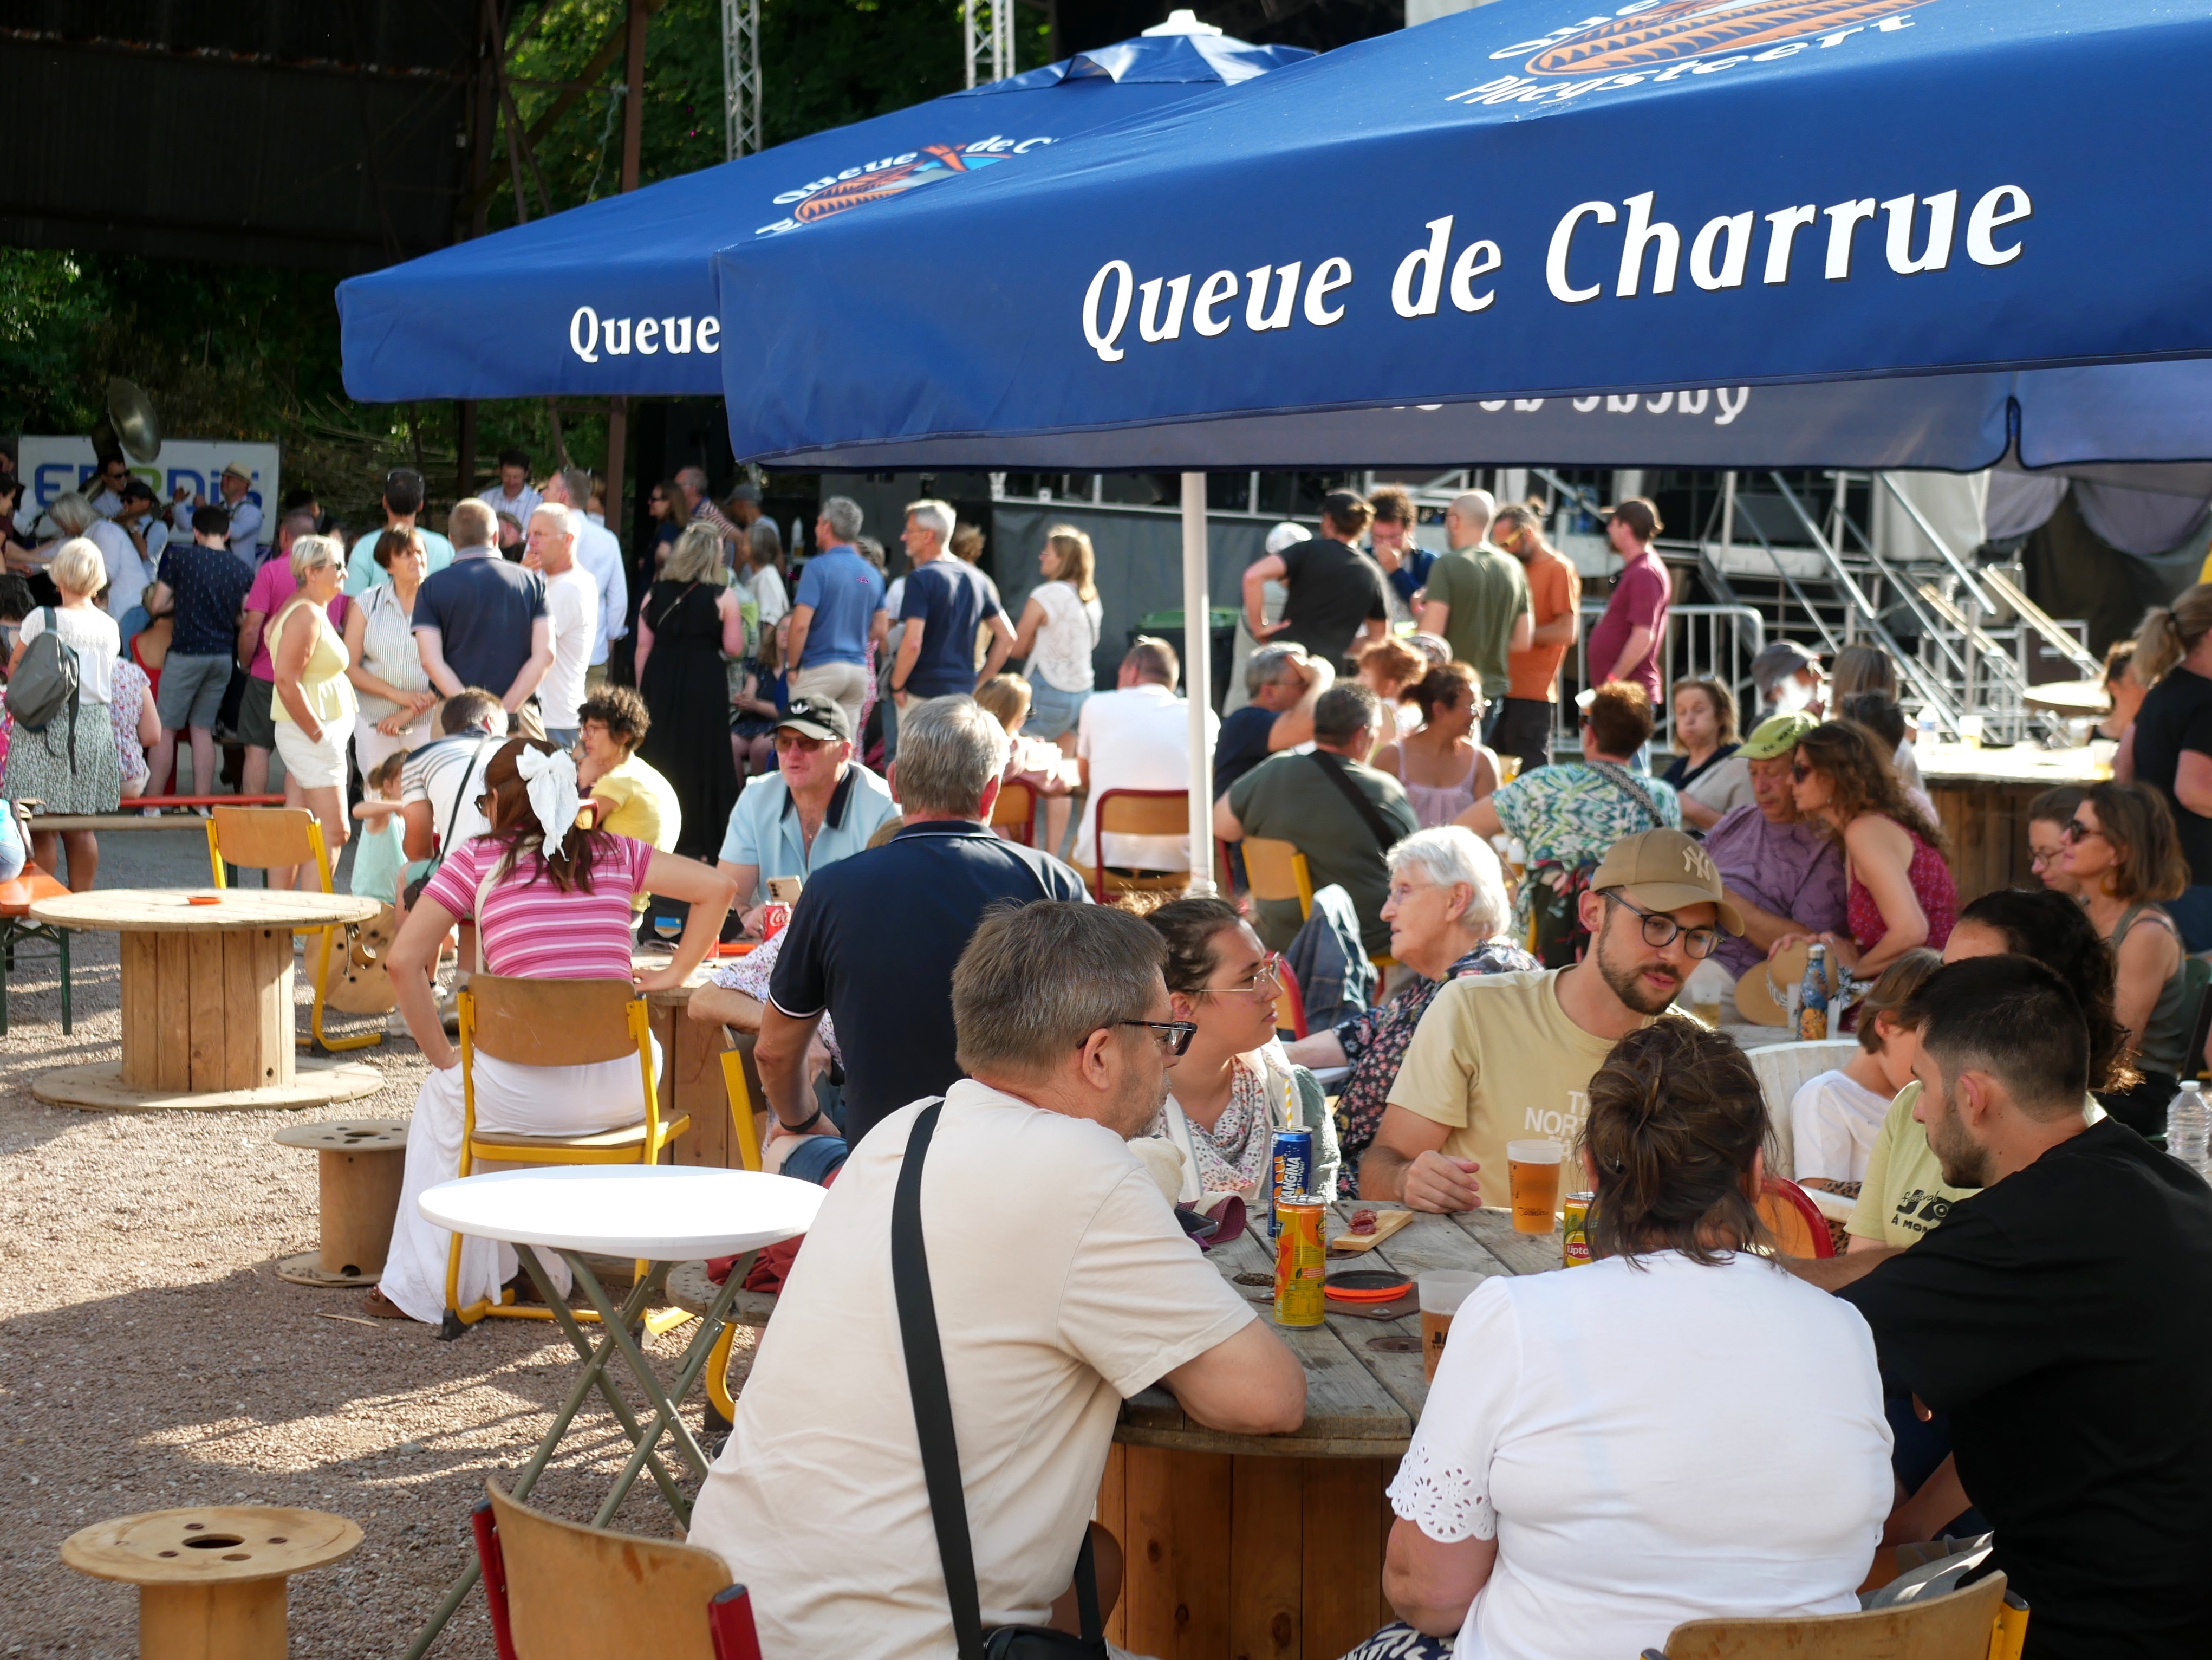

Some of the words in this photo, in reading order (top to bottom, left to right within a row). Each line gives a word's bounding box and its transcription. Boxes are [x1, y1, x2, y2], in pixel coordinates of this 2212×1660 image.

[773, 152, 918, 205] Queue
[965, 135, 1015, 153] de
[1082, 256, 1353, 363] Queue
[1391, 214, 1502, 319] de
[1545, 184, 2032, 303] Charrue
[569, 305, 721, 364] Queue
